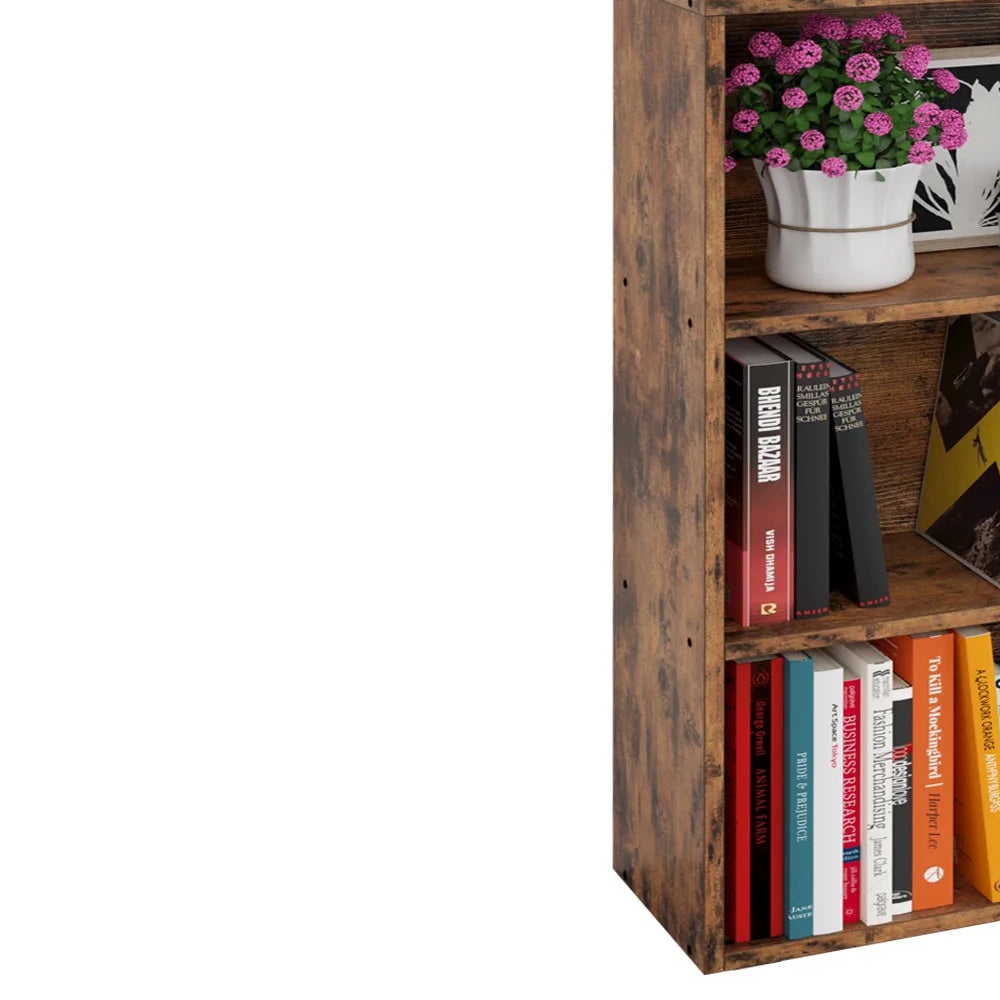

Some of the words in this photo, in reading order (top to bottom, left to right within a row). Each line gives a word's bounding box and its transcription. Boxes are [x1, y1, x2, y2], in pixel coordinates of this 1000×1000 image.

[757, 386, 781, 432] BHENDI
[796, 413, 828, 423] SCHNEE
[757, 434, 781, 483] BAZAAR
[765, 529, 775, 552] VISH
[764, 553, 775, 593] DHAMIJA
[929, 655, 941, 673] To
[928, 673, 942, 695] Kill
[753, 701, 767, 729] George
[929, 696, 938, 704] a
[830, 717, 839, 742] Space
[843, 714, 856, 774] BUSINESS
[872, 708, 893, 750] Fashion
[926, 705, 942, 780] Mockingbird
[981, 721, 995, 752] ORANGE
[796, 751, 808, 780] PRIDE
[830, 744, 838, 768] Tokyo
[755, 768, 769, 813] ANIMAL
[867, 750, 893, 831] Merchandising
[795, 791, 808, 843] PREJUDICE
[843, 776, 856, 844] RESEARCH
[926, 792, 941, 830] Harper
[755, 814, 768, 845] FARM
[928, 832, 941, 850] Lee
